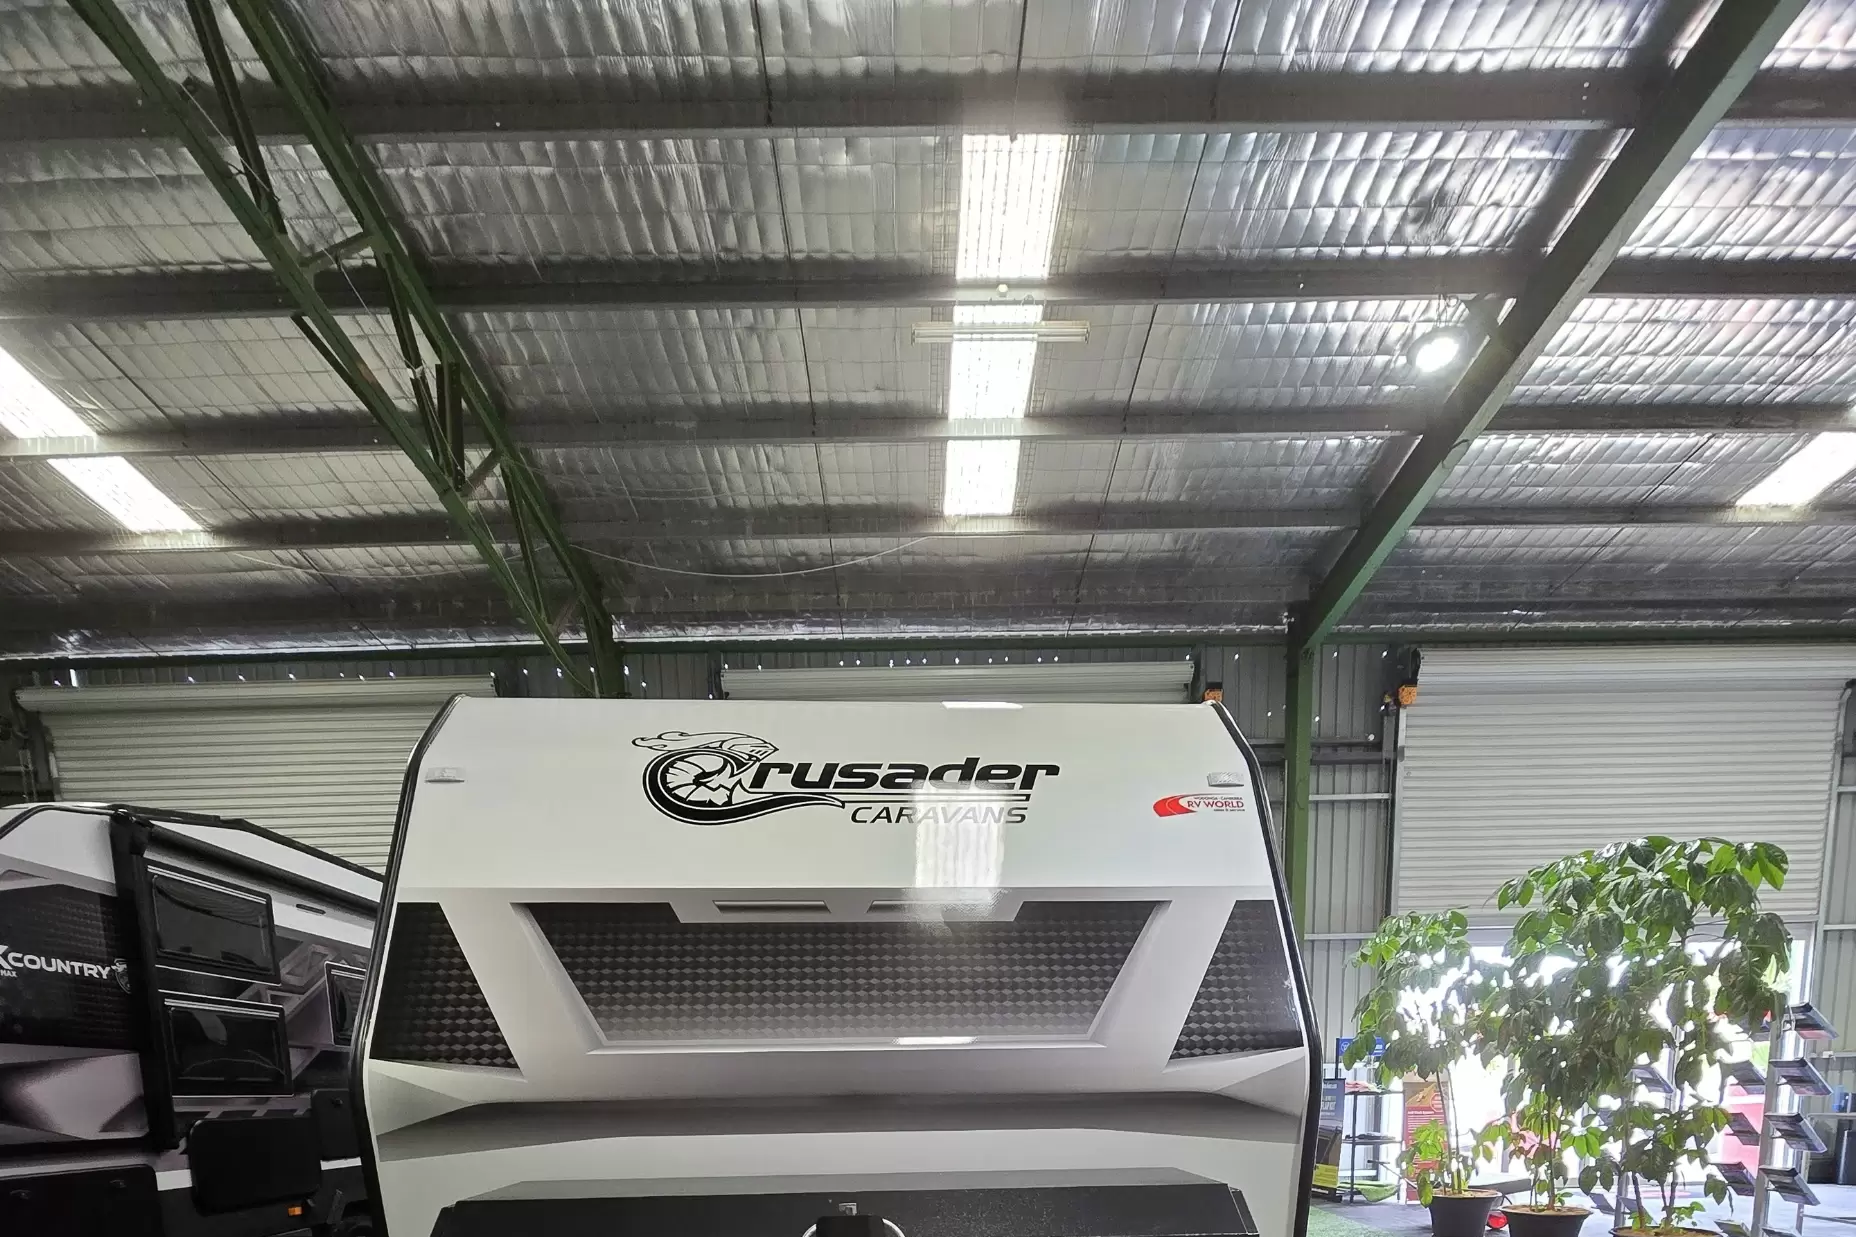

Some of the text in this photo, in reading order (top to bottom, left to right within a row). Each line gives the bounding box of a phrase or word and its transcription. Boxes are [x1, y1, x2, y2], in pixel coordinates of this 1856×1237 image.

[641, 745, 1060, 827] Crusader
[1187, 800, 1245, 809] RV WORLD
[850, 805, 1028, 825] CARAVANS
